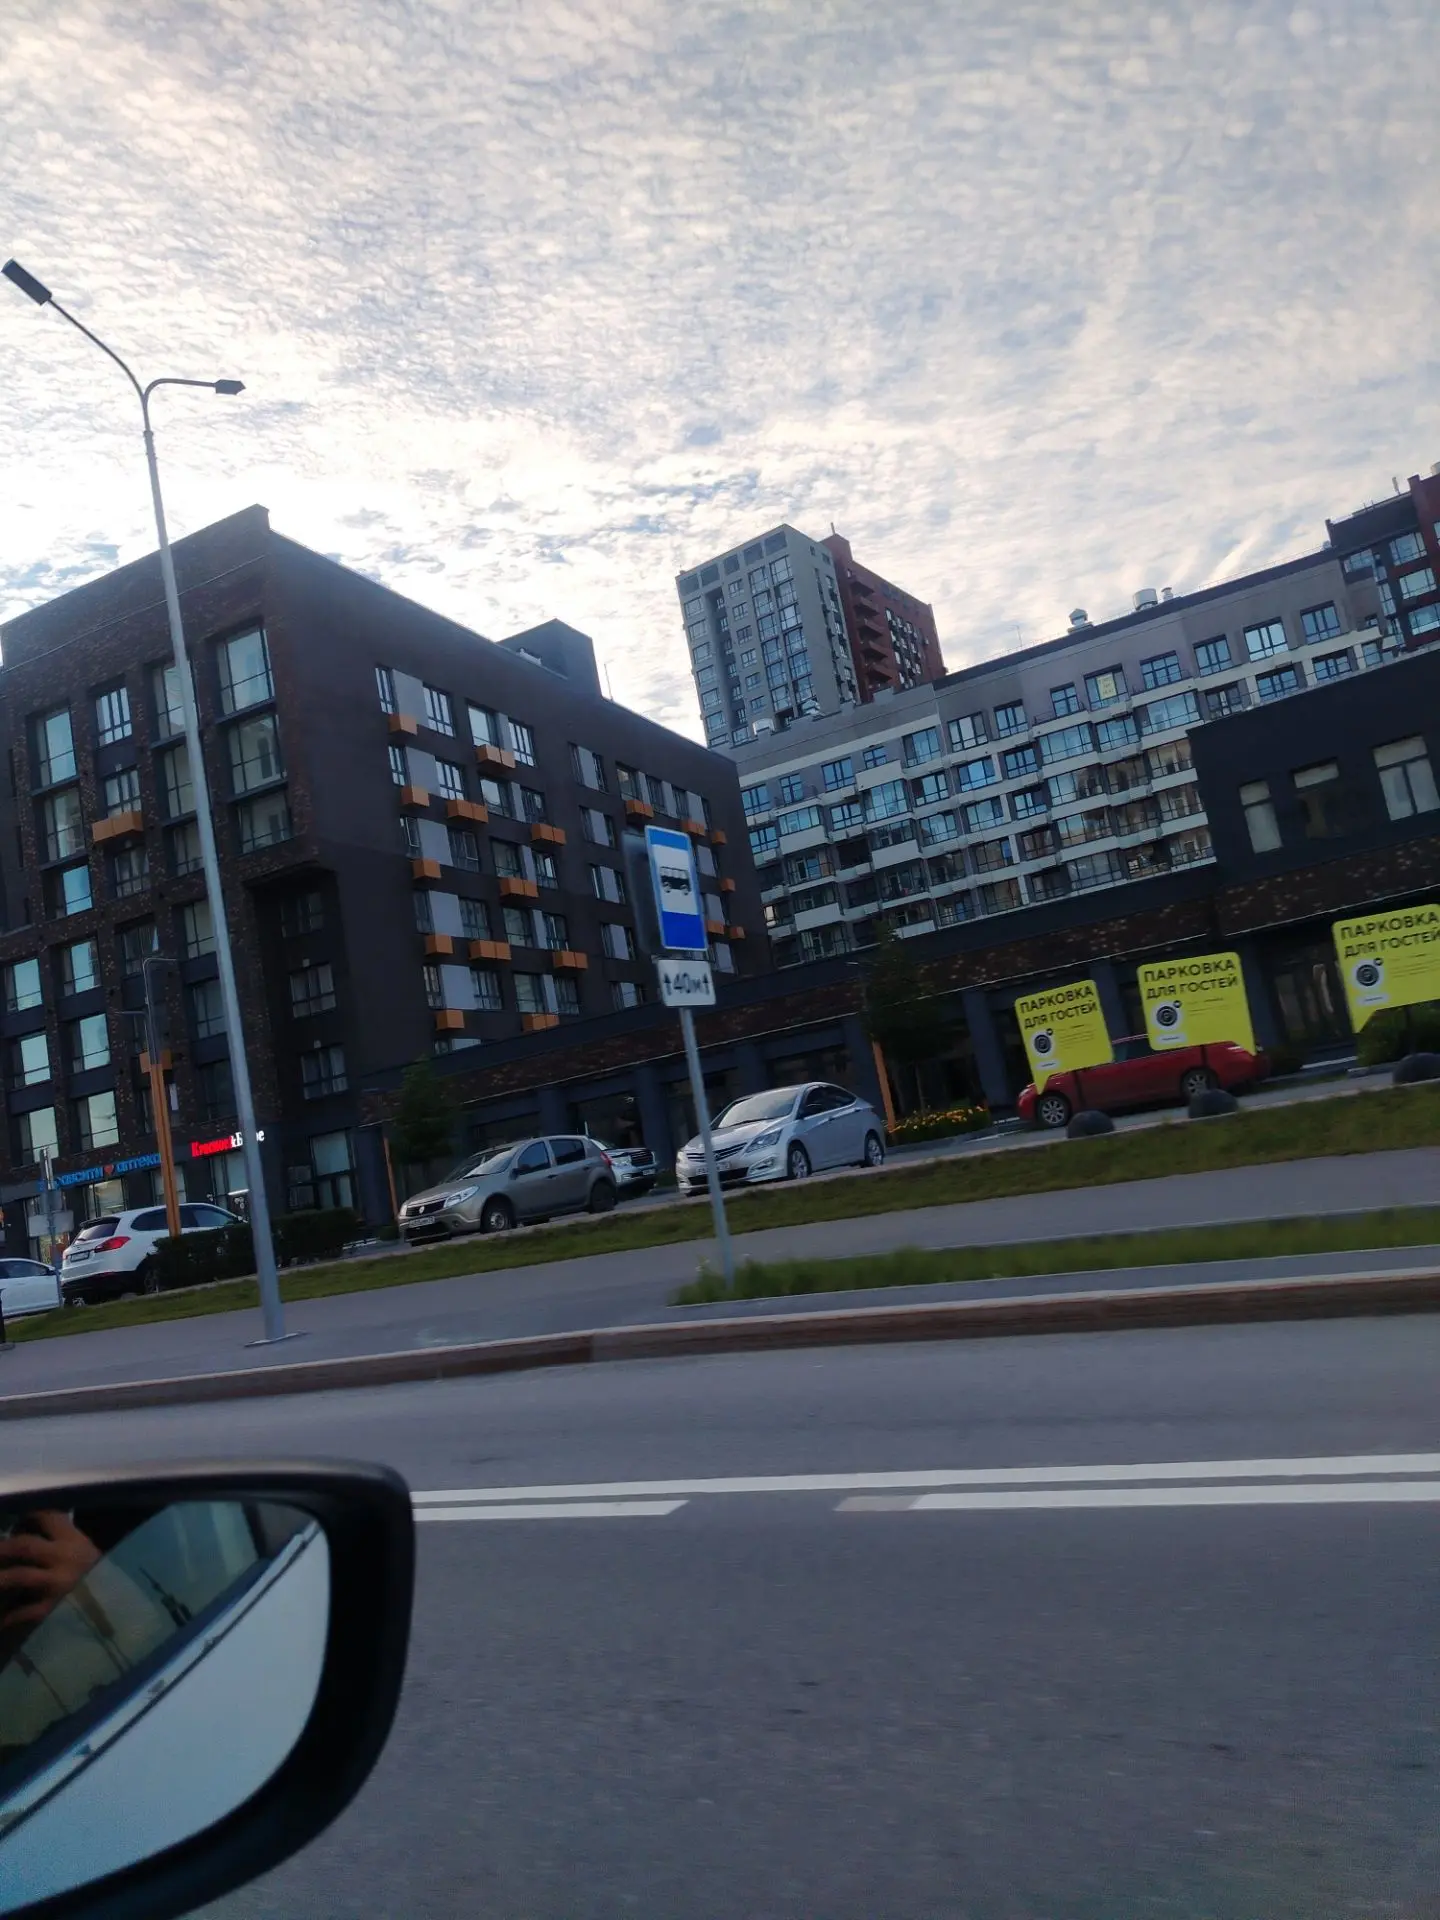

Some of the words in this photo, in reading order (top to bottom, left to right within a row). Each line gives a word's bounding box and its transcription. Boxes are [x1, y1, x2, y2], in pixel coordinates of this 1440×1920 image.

[1341, 912, 1439, 940] ПАРКОВКА
[1344, 941, 1378, 958] ДЛЯ
[1144, 959, 1235, 982] ПАРКОВКА
[1020, 986, 1093, 1014] ПАРКОВКА
[1147, 984, 1177, 1000] ДЛЯ
[1180, 973, 1238, 994] ГОСТЕЙ
[1025, 1014, 1048, 1029] ДЛЯ
[1050, 1000, 1098, 1022] ГОСТЕЙ
